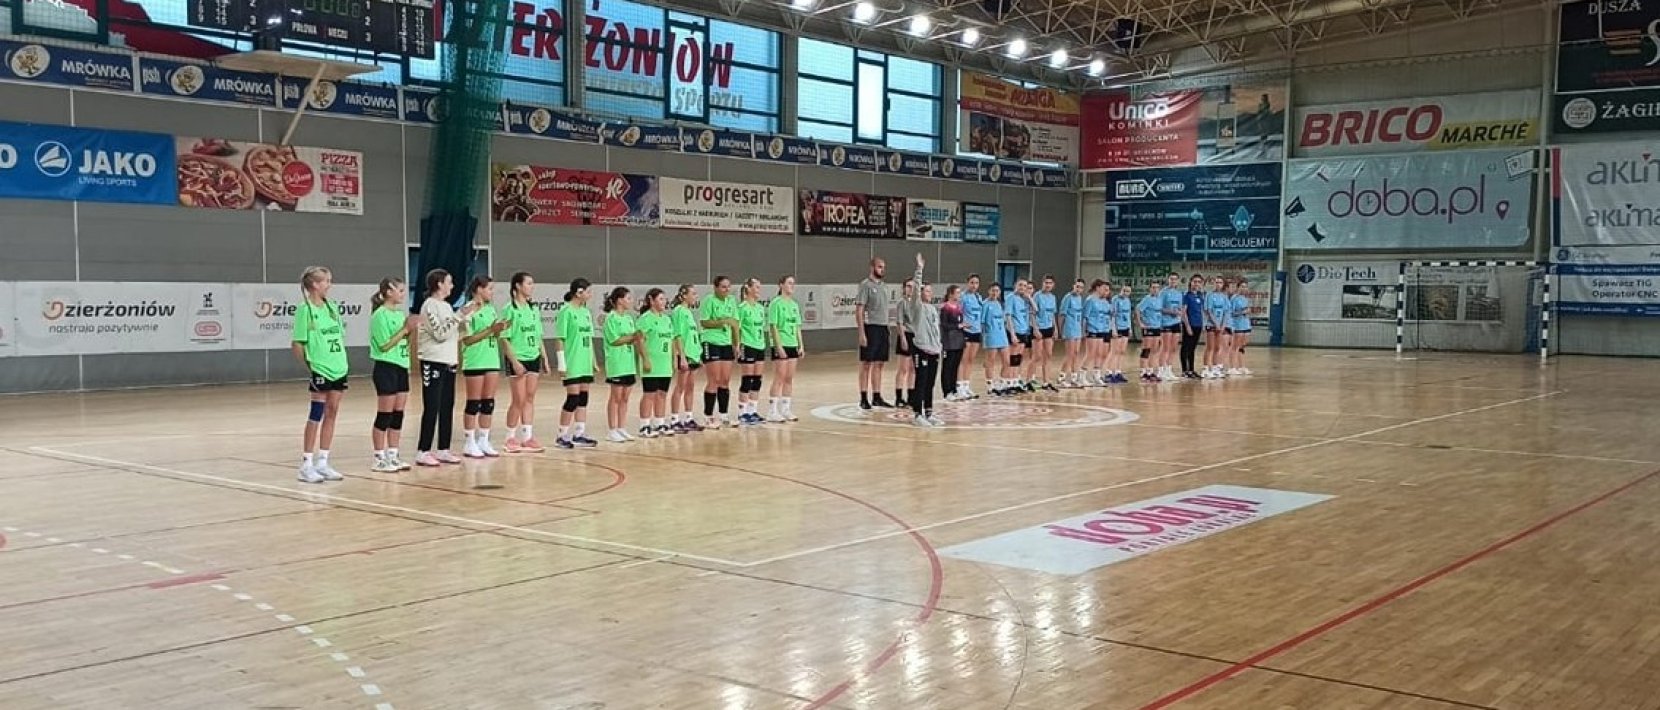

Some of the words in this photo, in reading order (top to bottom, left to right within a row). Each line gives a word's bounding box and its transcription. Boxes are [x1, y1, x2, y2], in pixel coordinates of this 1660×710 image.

[61, 58, 131, 80] MRÓWKA
[213, 76, 273, 96] MRÓWKA
[345, 92, 397, 109] MRÓWKA
[1108, 120, 1170, 131] KOMINKI
[1300, 104, 1443, 147] BRICO
[78, 149, 156, 178] JAKO
[321, 152, 357, 167] PIZZA
[106, 177, 137, 188] SPORTS
[684, 184, 774, 207] progresart
[1328, 174, 1486, 224] doba.pl
[823, 203, 867, 224] TROFEA
[1210, 237, 1275, 248] KIBICUJEMY!
[1592, 290, 1635, 299] Operator
[1637, 290, 1659, 298] CNC
[327, 338, 341, 353] 25
[1042, 494, 1262, 544] doba.pl
